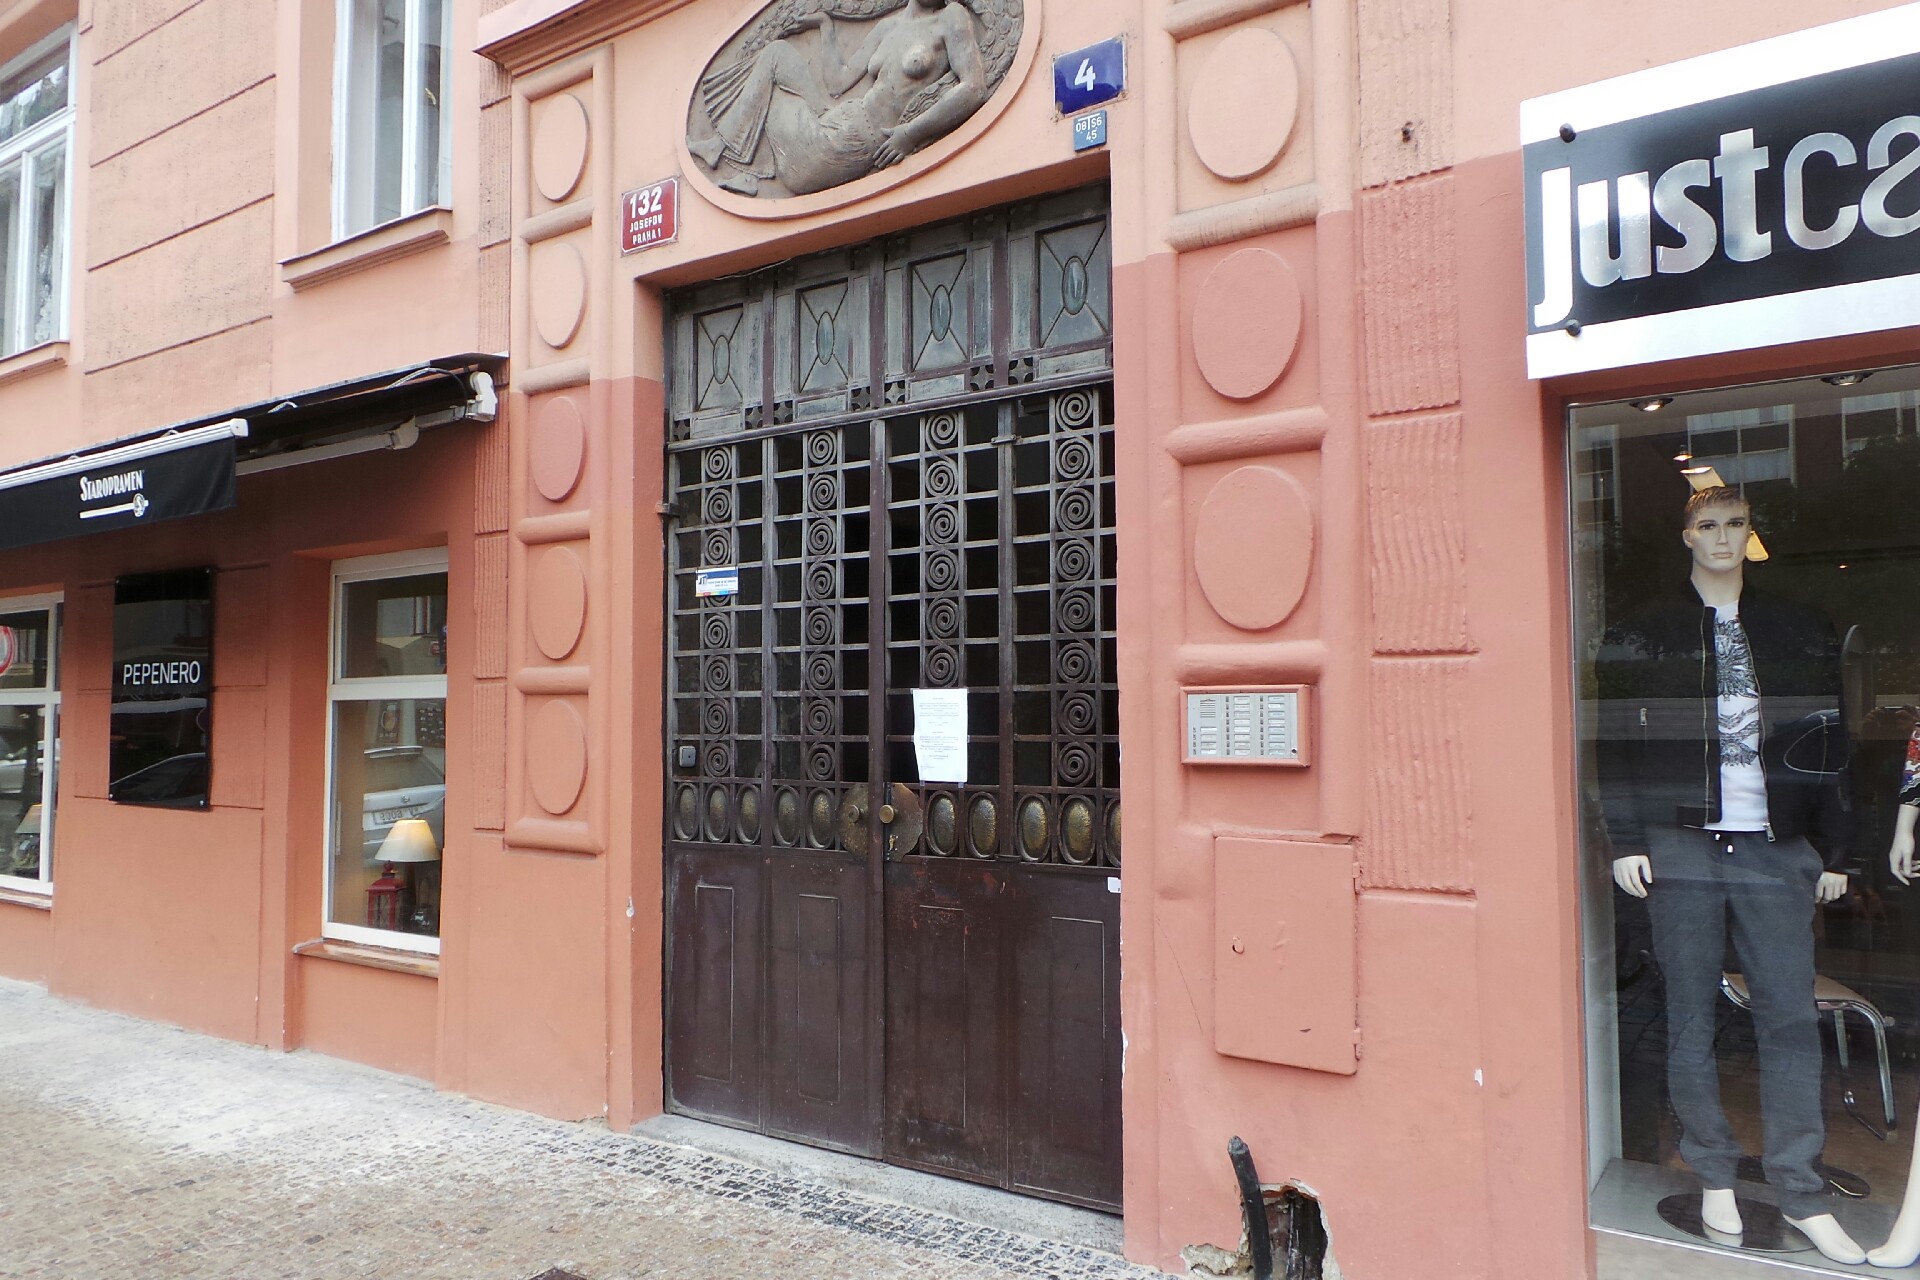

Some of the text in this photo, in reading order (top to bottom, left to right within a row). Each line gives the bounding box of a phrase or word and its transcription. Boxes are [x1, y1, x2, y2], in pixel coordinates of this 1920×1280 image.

[1074, 57, 1096, 91] 4
[630, 186, 663, 219] 132
[630, 213, 663, 233] JOSEFOV
[632, 229, 657, 245] PRAHA
[79, 469, 144, 501] STAROPRAMEN
[122, 660, 201, 686] PEPENERO
